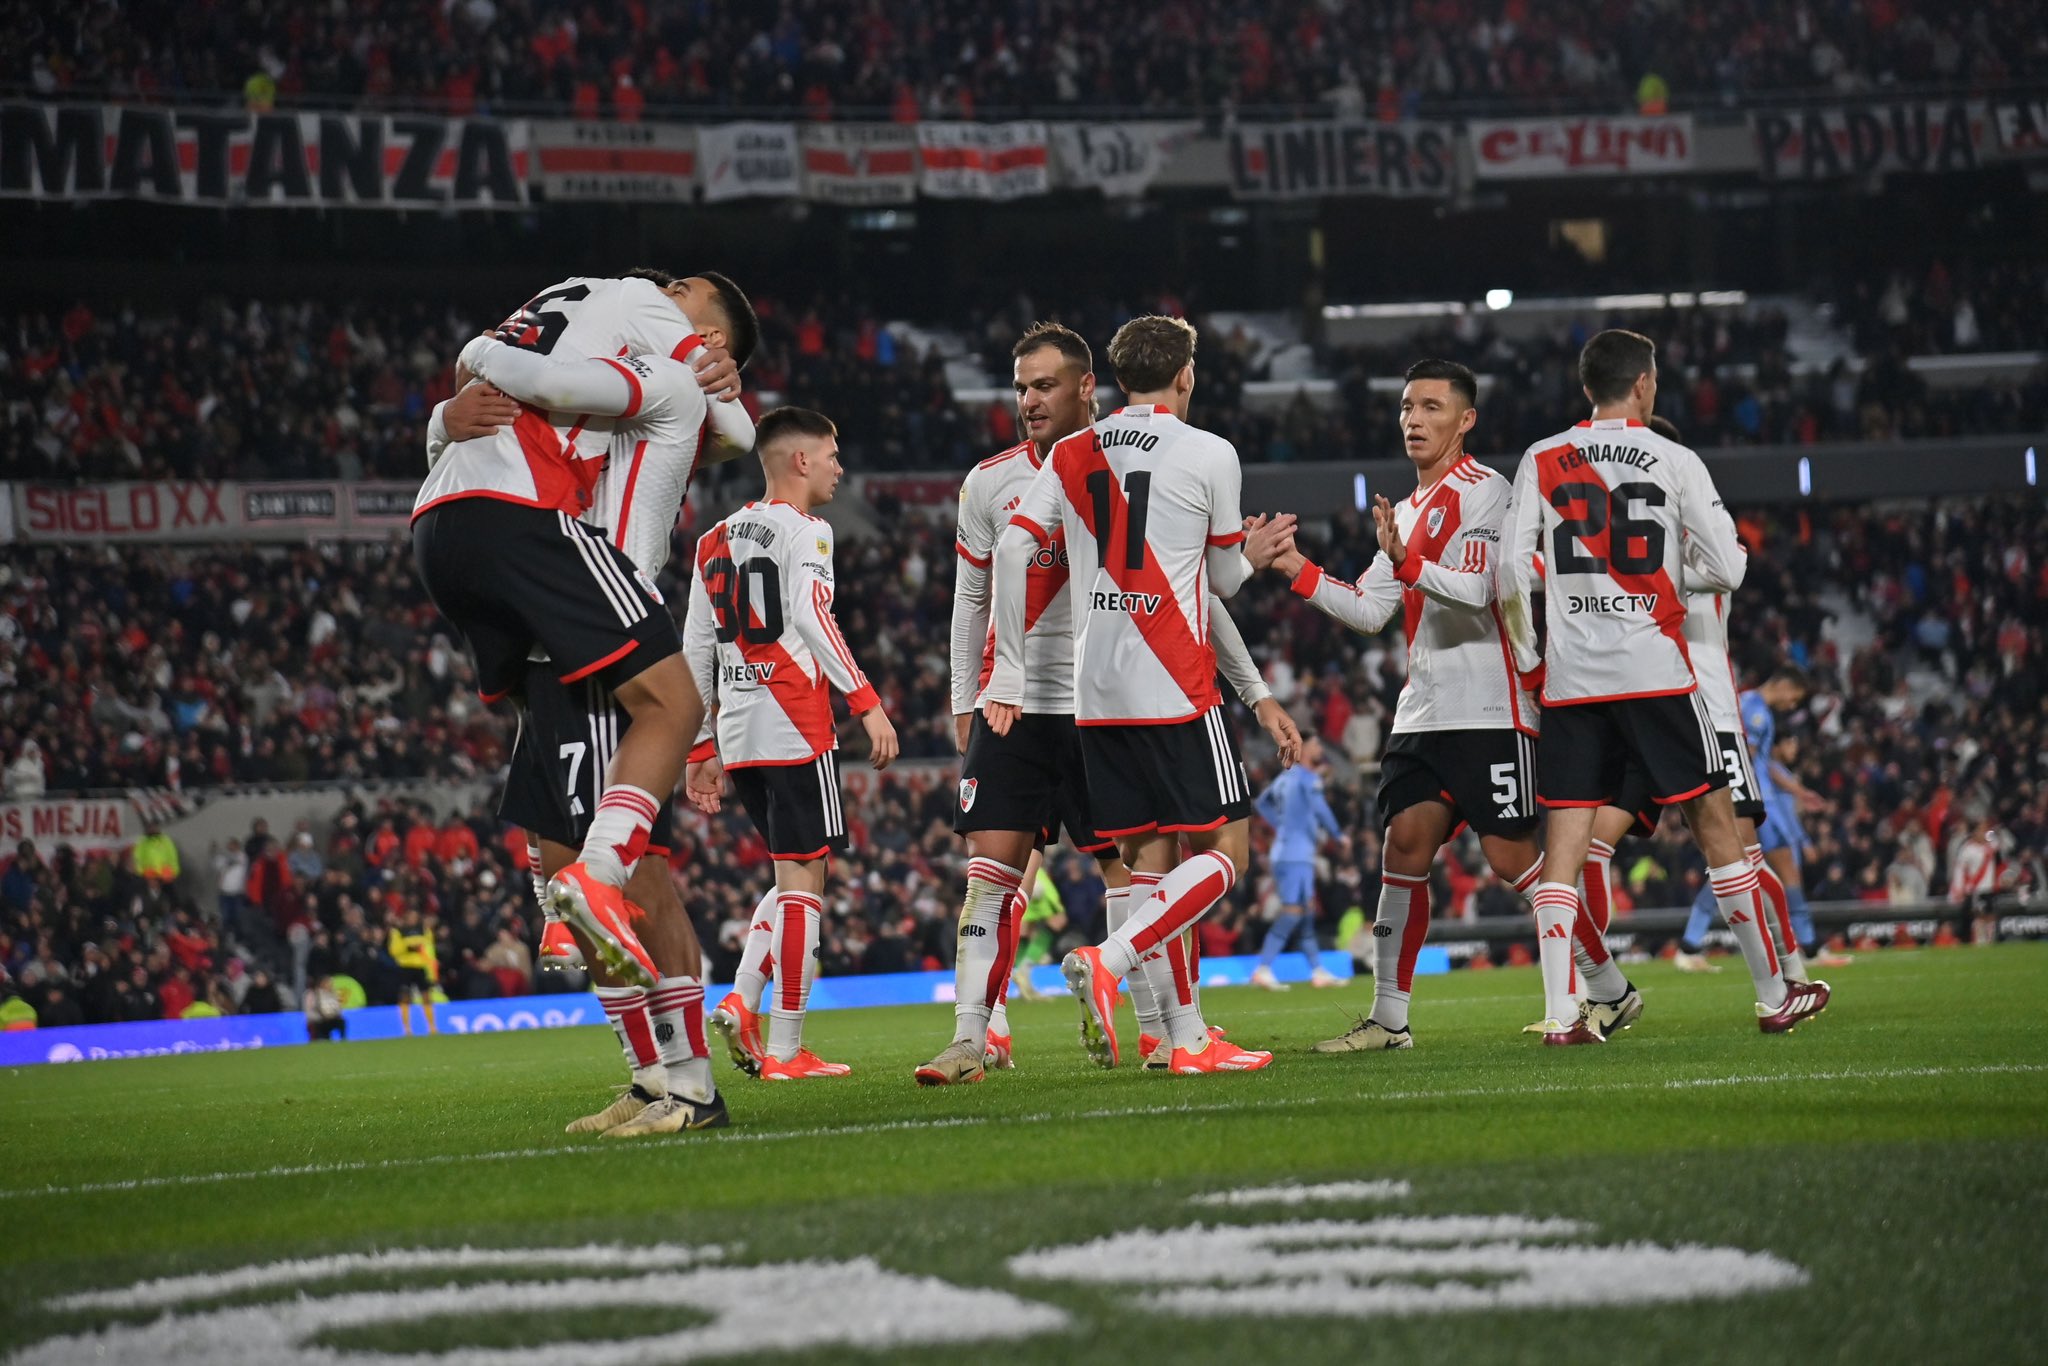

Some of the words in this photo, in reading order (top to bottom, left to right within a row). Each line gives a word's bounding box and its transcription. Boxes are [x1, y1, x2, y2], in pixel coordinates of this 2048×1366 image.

[0, 106, 519, 200] MATANZA
[1230, 126, 1450, 192] LINIERS
[1757, 102, 1978, 180] PADUA
[1093, 429, 1160, 453] COLIDIO
[1558, 444, 1659, 473] FERNANDEZ
[26, 486, 160, 533] SIGLO
[170, 482, 226, 528] XX
[1086, 470, 1151, 569] 11
[1550, 482, 1666, 575] 26
[704, 557, 784, 644] 30
[1089, 592, 1160, 613] RECTV
[1568, 596, 1656, 614] DIRECTV
[723, 663, 774, 683] DRECTV
[559, 742, 587, 797] 7
[1490, 762, 1518, 804] 5
[1722, 749, 1745, 788] 3
[33, 806, 121, 837] MEJIA
[449, 1009, 585, 1033] 100%
